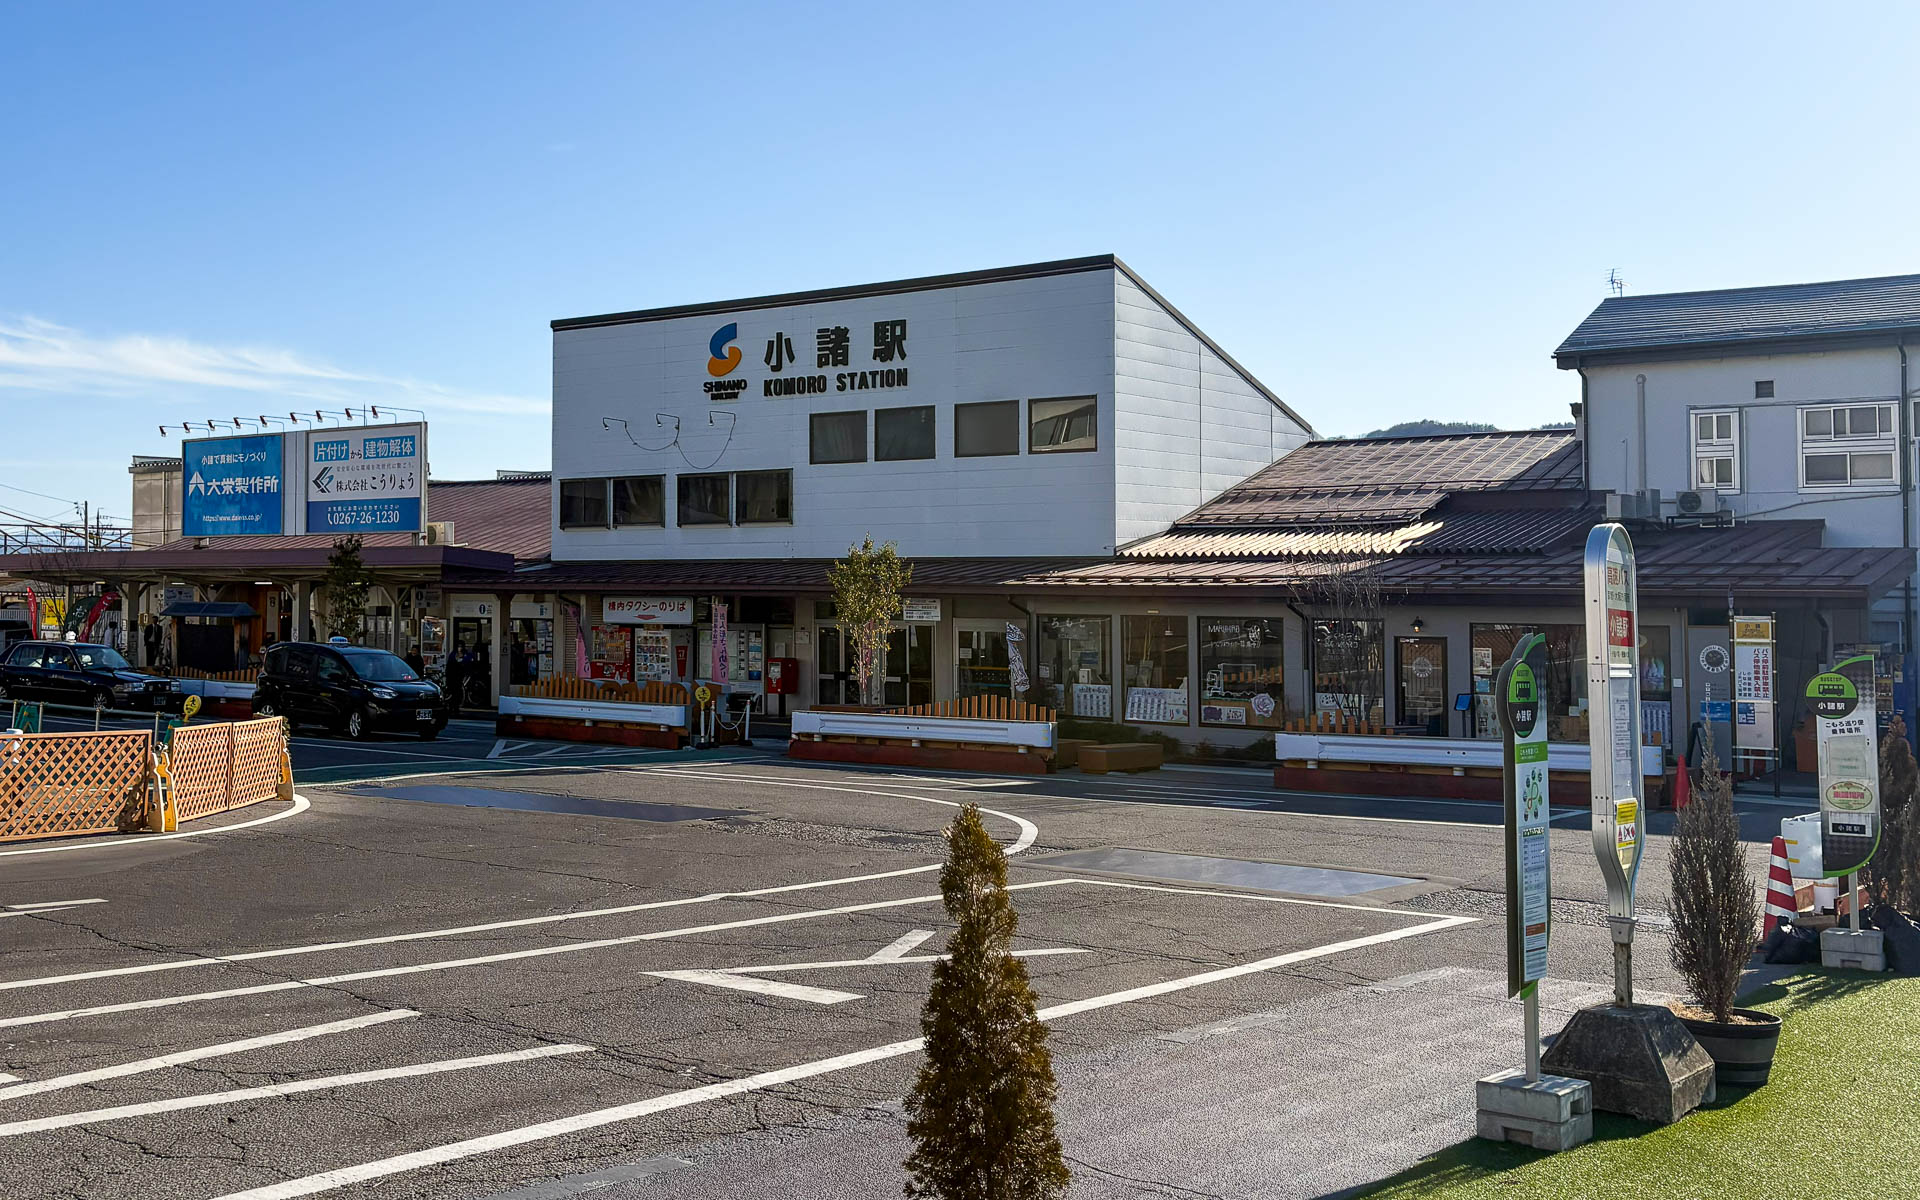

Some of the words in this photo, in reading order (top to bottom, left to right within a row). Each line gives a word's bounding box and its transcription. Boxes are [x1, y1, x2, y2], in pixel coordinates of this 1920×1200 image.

[764, 319, 907, 372] 小諸駅
[703, 380, 748, 393] SHINANO
[763, 375, 827, 397] KOMORO
[836, 368, 908, 392] STATION
[316, 442, 348, 460] 片付け
[351, 449, 363, 459] から
[365, 437, 414, 458] 建物解体
[207, 475, 278, 496] 大栄製作所
[333, 510, 400, 524] 0267-26-1230
[1610, 615, 1629, 638] 小諸駅
[1817, 702, 1846, 711] 小諸駅
[1515, 710, 1532, 722] 小諸駅
[1826, 719, 1864, 729] こもろ巡り便
